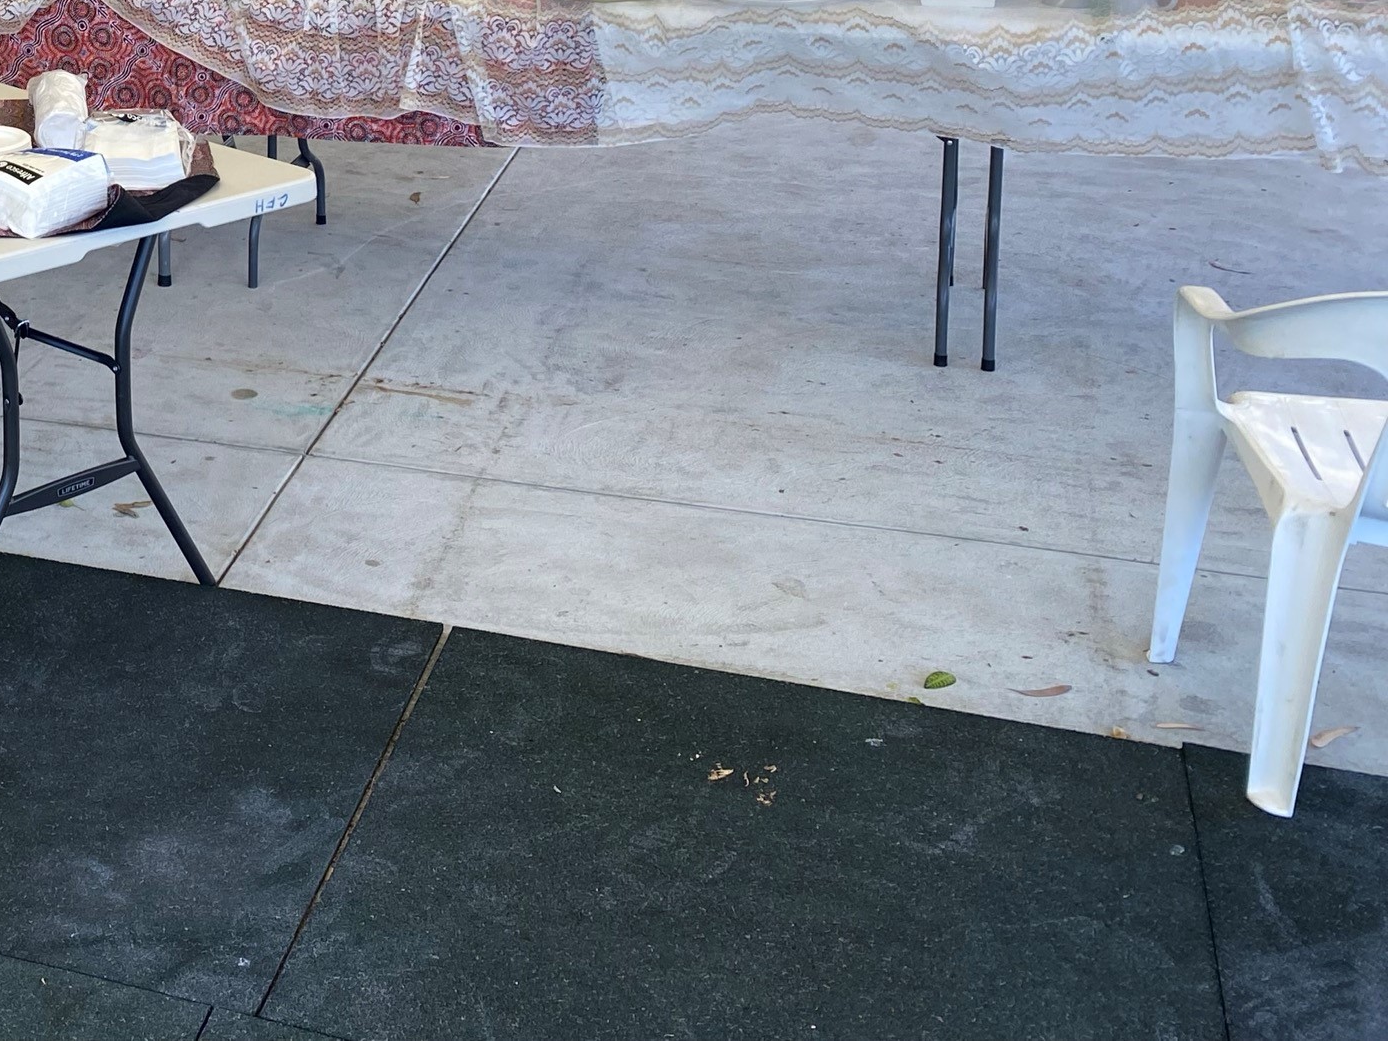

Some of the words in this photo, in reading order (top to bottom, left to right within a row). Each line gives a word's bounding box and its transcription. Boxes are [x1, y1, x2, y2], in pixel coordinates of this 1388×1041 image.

[5, 164, 36, 181] Alfresco
[255, 193, 289, 213] CFH
[62, 479, 92, 494] LIFETIME
